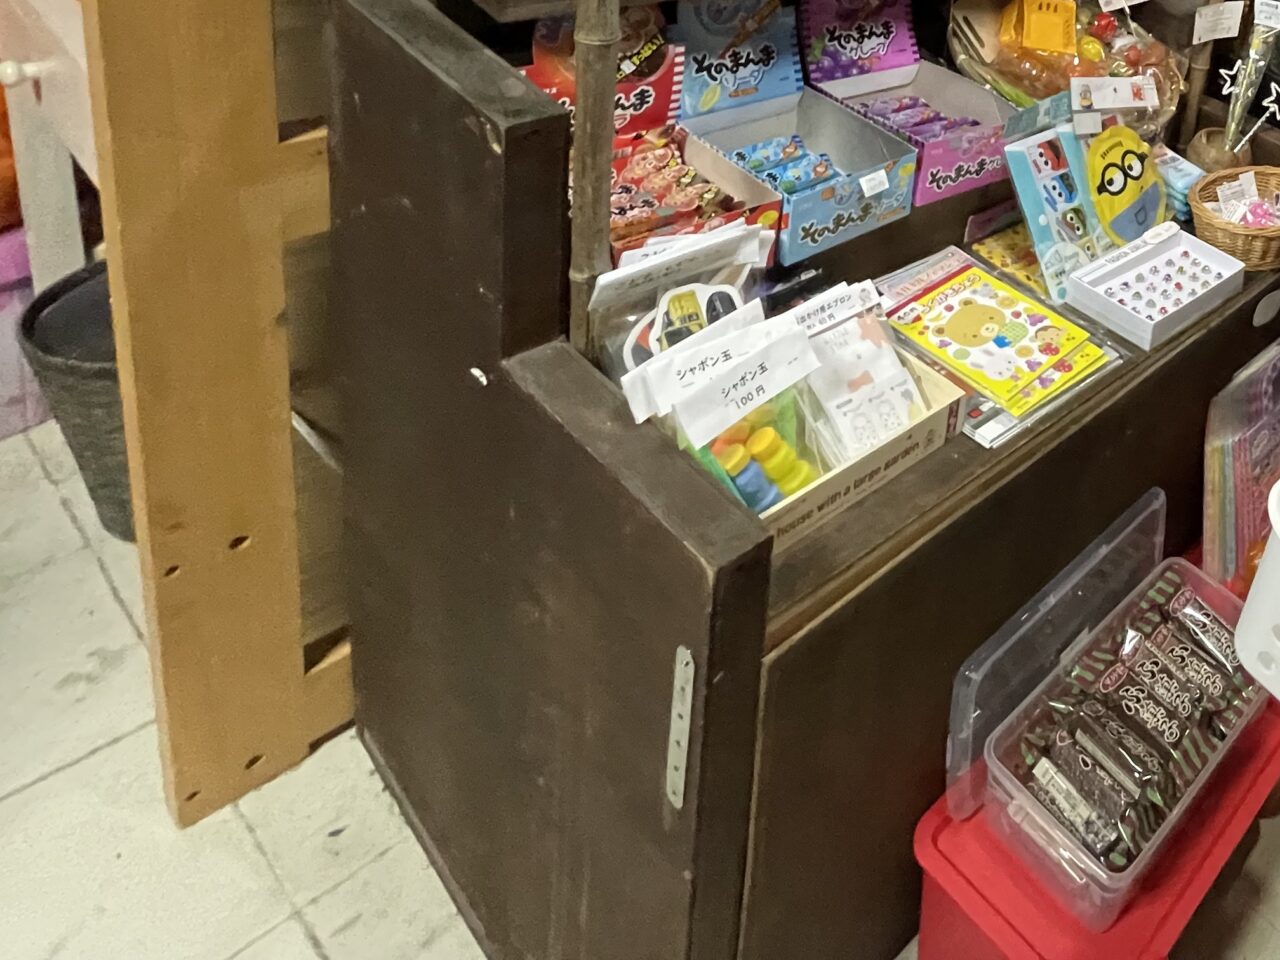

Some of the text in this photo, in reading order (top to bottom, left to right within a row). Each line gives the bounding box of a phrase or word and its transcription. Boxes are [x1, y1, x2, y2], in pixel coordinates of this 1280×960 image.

[825, 20, 896, 50] そのまんま
[692, 44, 776, 82] そのまんま
[927, 155, 988, 190] そのまんま
[801, 202, 873, 244] そのまんま
[676, 349, 734, 381] シャボン玉
[720, 361, 769, 398] シャボン玉
[734, 384, 766, 410] 100円
[777, 441, 921, 538] house with a large garden
